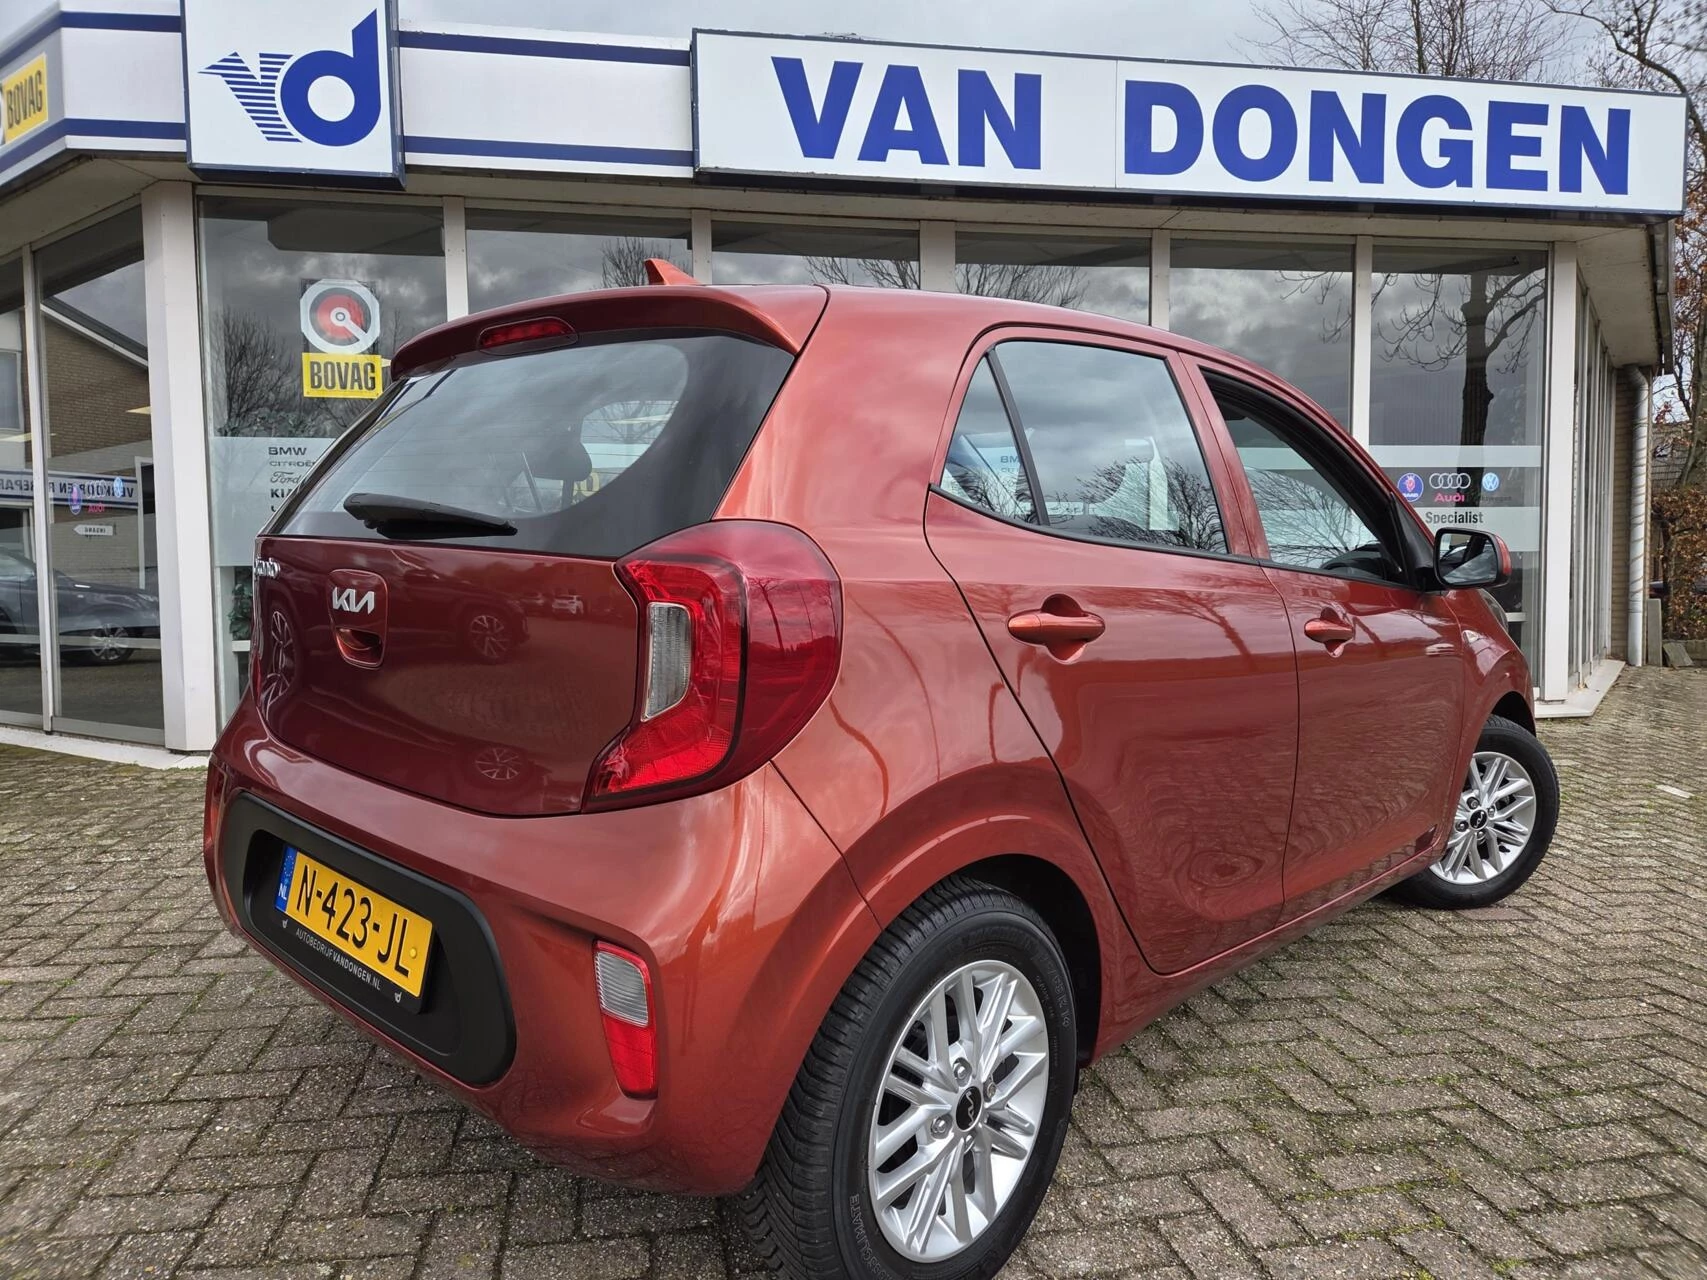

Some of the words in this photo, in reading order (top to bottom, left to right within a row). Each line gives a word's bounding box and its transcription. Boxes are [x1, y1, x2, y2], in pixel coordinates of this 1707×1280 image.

[6, 70, 43, 129] BOVAG
[771, 56, 1042, 170] VAN
[1124, 79, 1631, 195] DONGEN
[309, 360, 376, 391] BOVAG
[268, 446, 307, 456] BMW
[1434, 492, 1465, 502] Audi
[1425, 511, 1483, 524] Specialist
[332, 586, 375, 615] KIA
[278, 883, 288, 900] NL
[296, 864, 410, 978] N-423-JL
[295, 927, 381, 990] AUTOBEDRIJFVANDONGEN.NL
